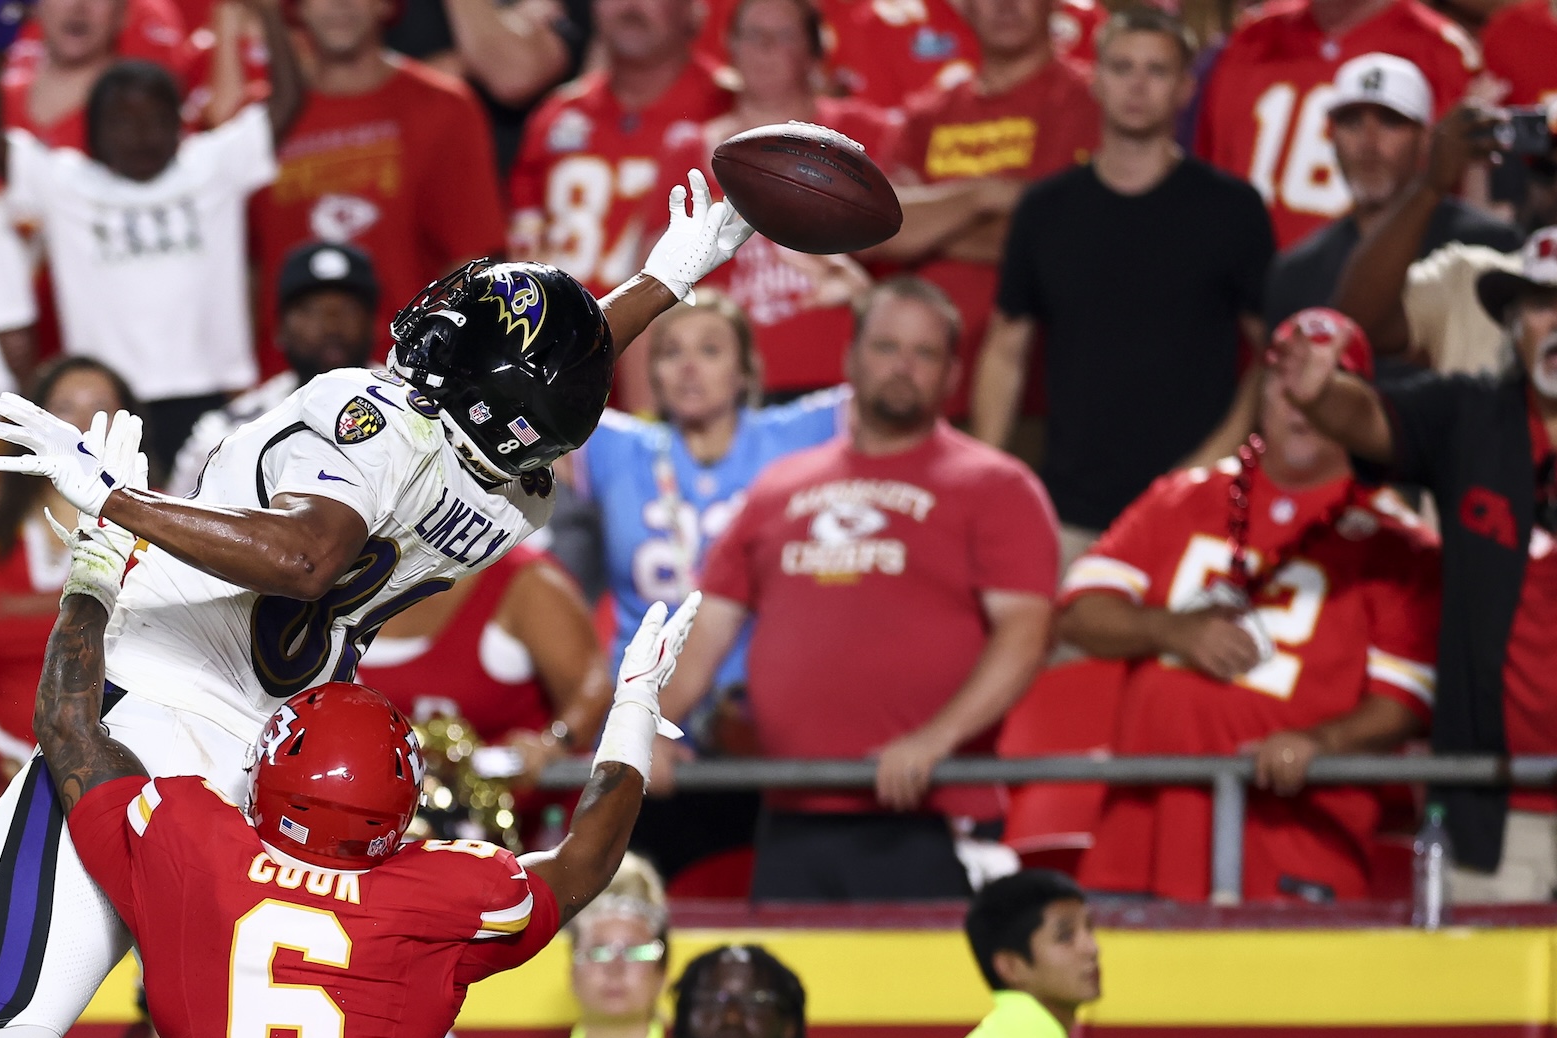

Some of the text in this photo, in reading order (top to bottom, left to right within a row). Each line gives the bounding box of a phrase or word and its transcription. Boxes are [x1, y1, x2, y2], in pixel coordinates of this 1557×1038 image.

[545, 153, 660, 288] 87
[355, 395, 385, 425] RAVENS
[414, 486, 511, 568] LIKELY
[248, 850, 361, 905] COOK
